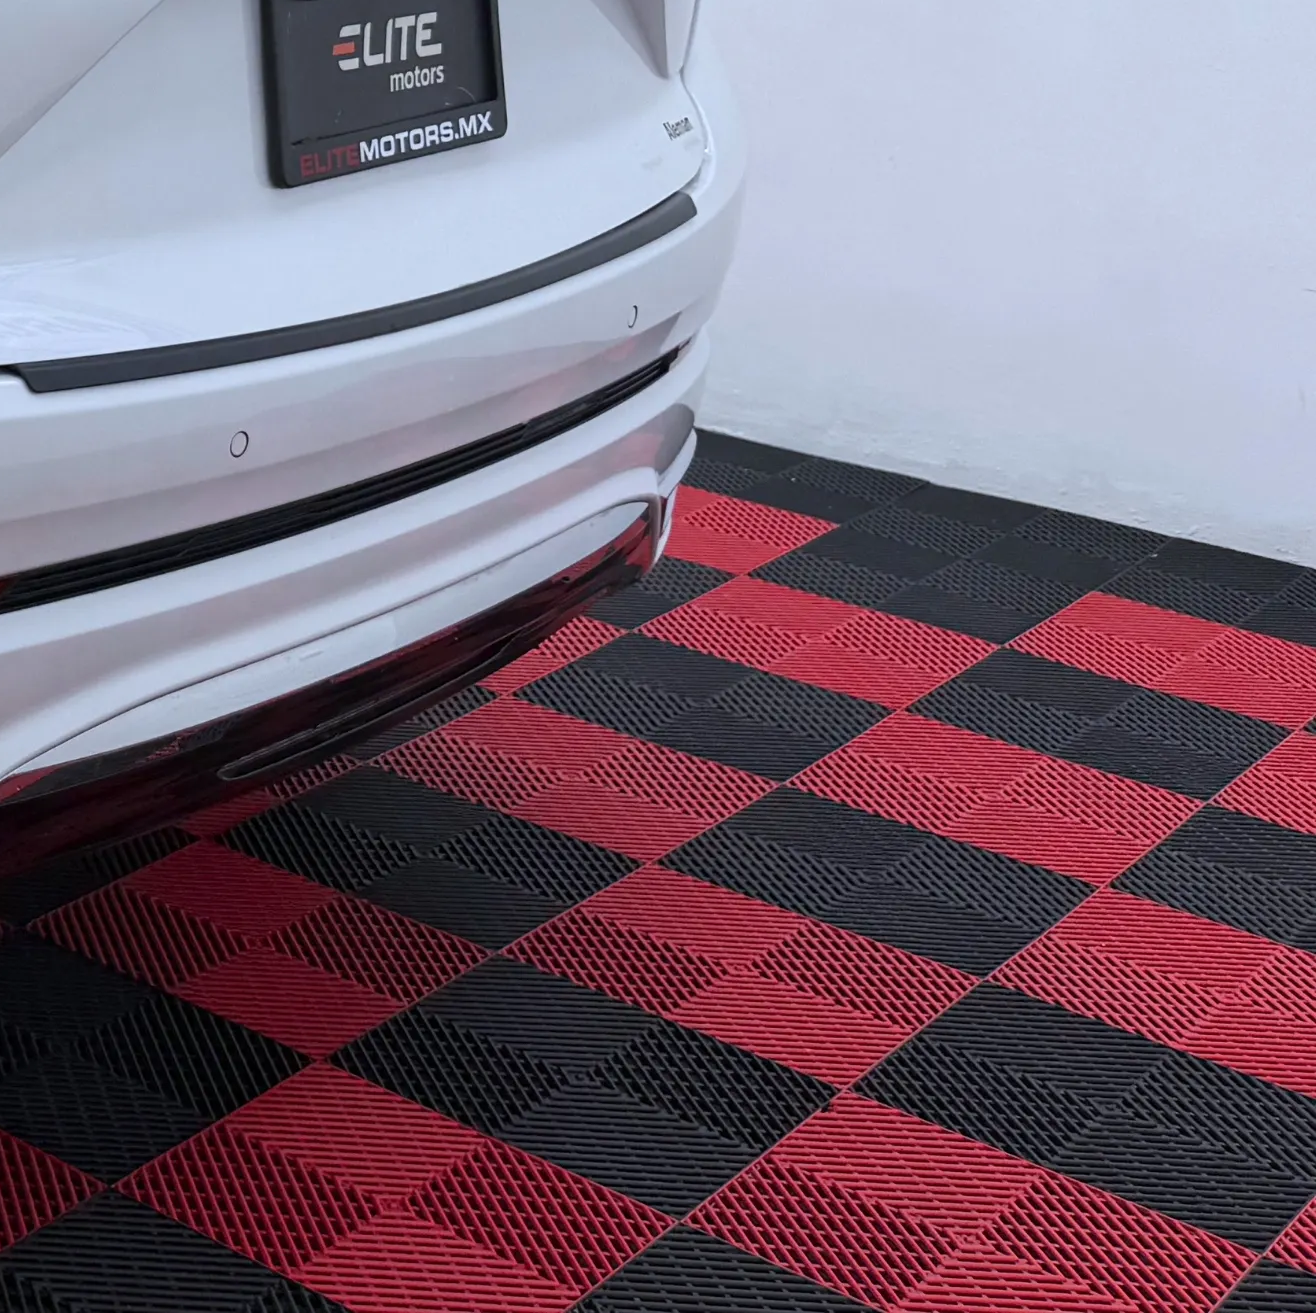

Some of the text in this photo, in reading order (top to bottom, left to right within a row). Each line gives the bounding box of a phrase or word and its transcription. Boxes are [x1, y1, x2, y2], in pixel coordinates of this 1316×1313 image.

[332, 11, 442, 71] ELITE
[389, 64, 445, 93] motors
[299, 110, 494, 177] ELITEMOTORS.MX
